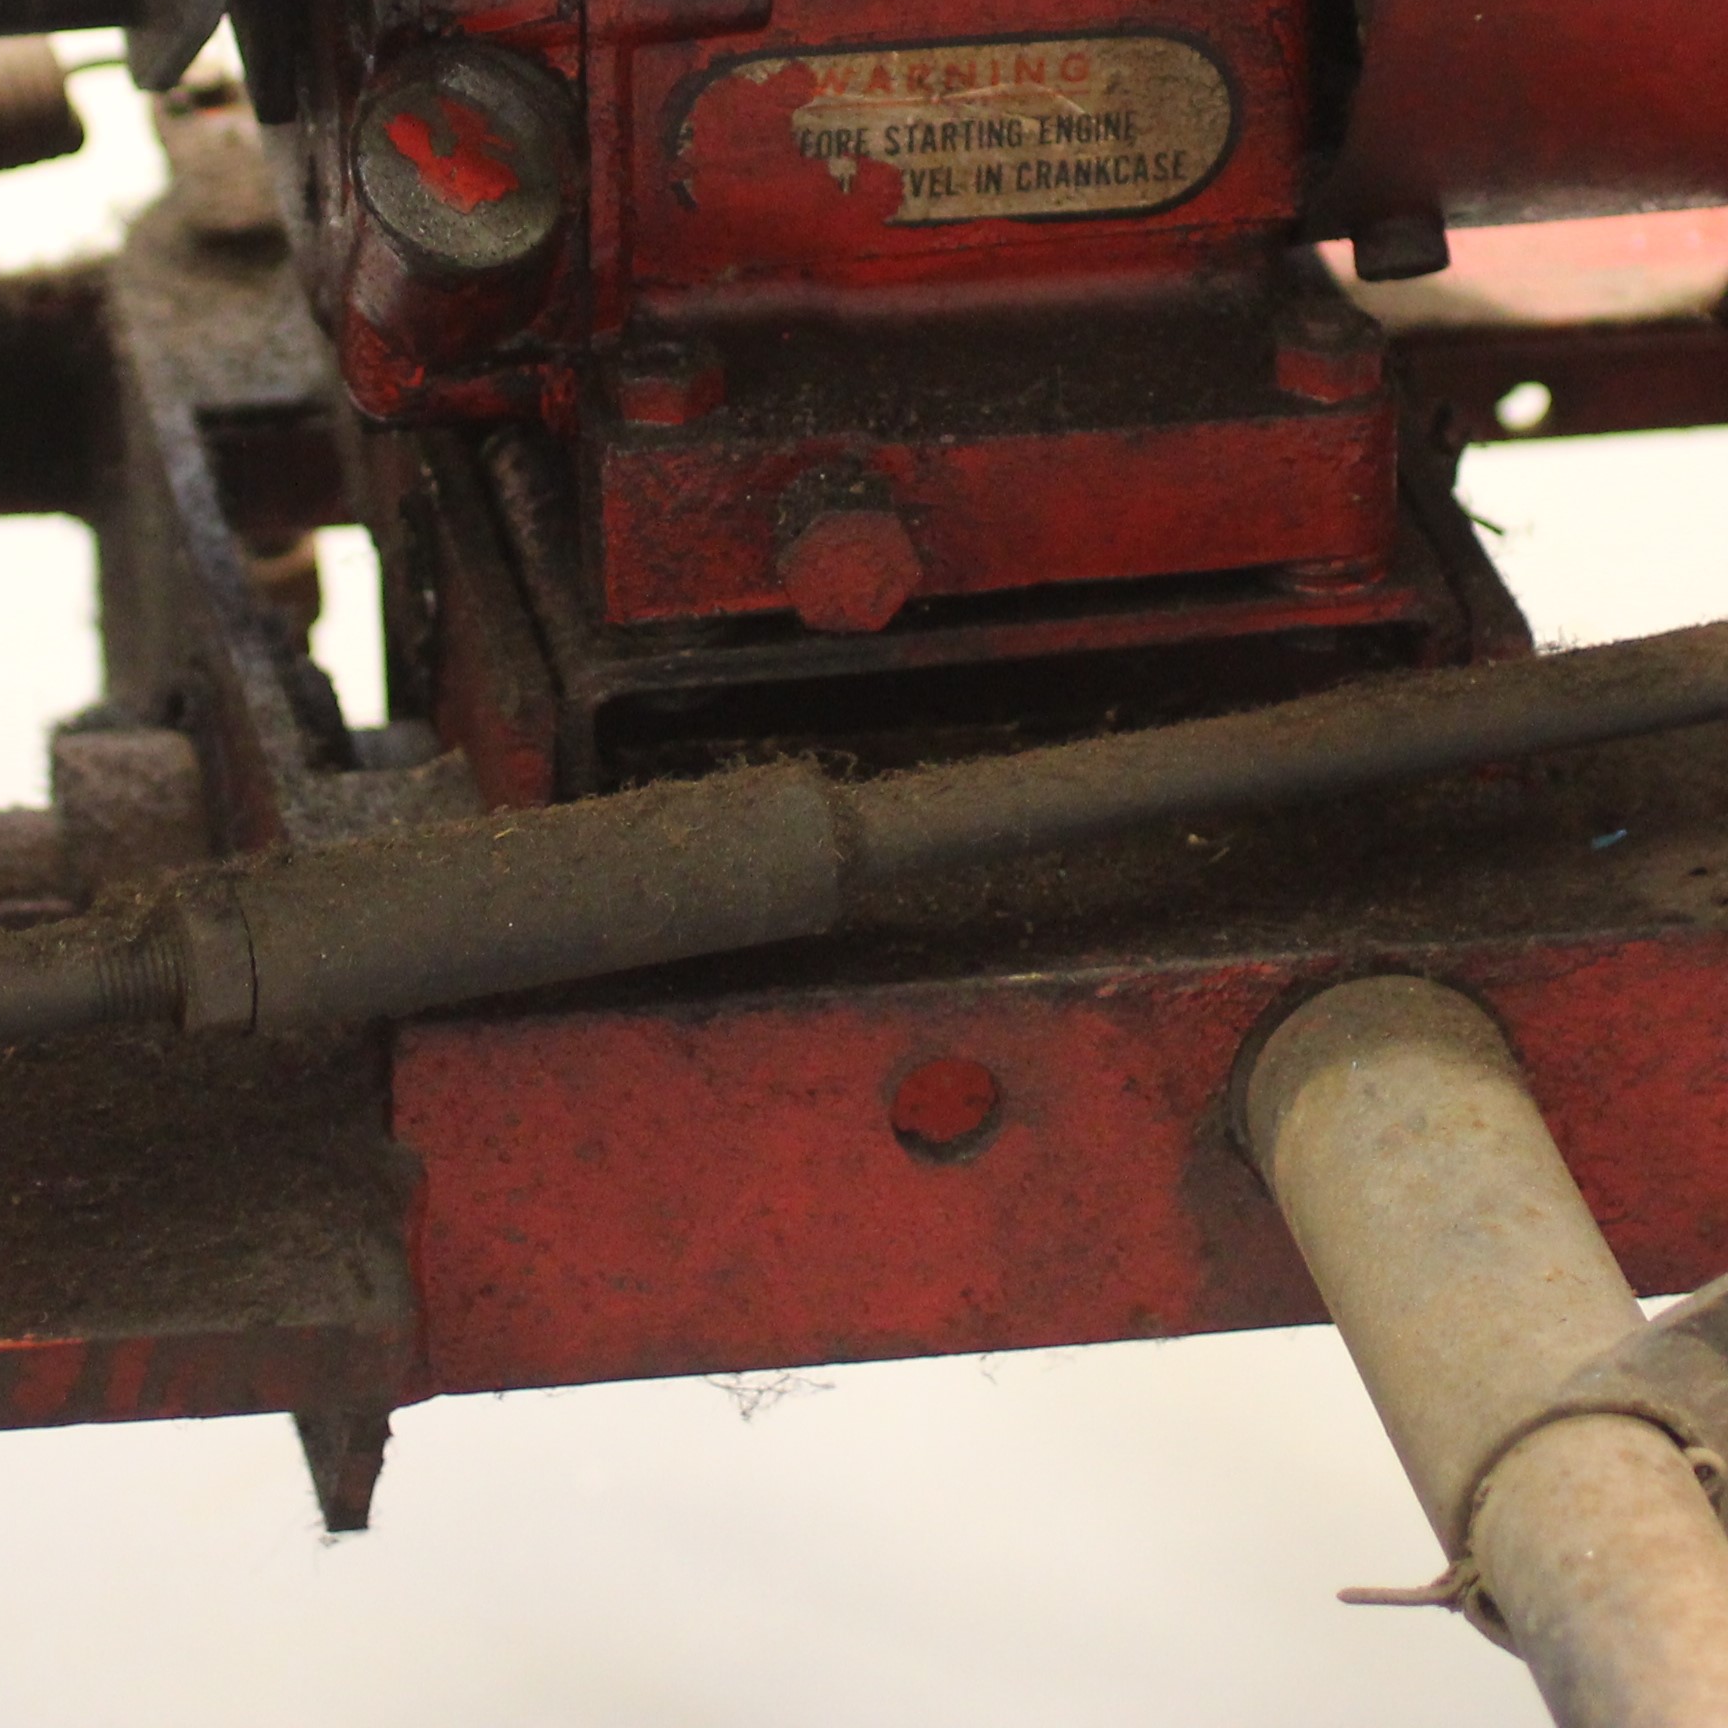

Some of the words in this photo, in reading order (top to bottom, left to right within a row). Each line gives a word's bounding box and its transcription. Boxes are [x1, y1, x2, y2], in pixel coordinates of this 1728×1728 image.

[813, 51, 1091, 97] WARNING
[791, 126, 871, 160] FORE
[883, 118, 1023, 157] STARTING
[1037, 110, 1138, 146] ENGINE
[901, 166, 961, 200] VEL
[973, 161, 1004, 195] IN
[1015, 149, 1189, 193] CRANKCASE
